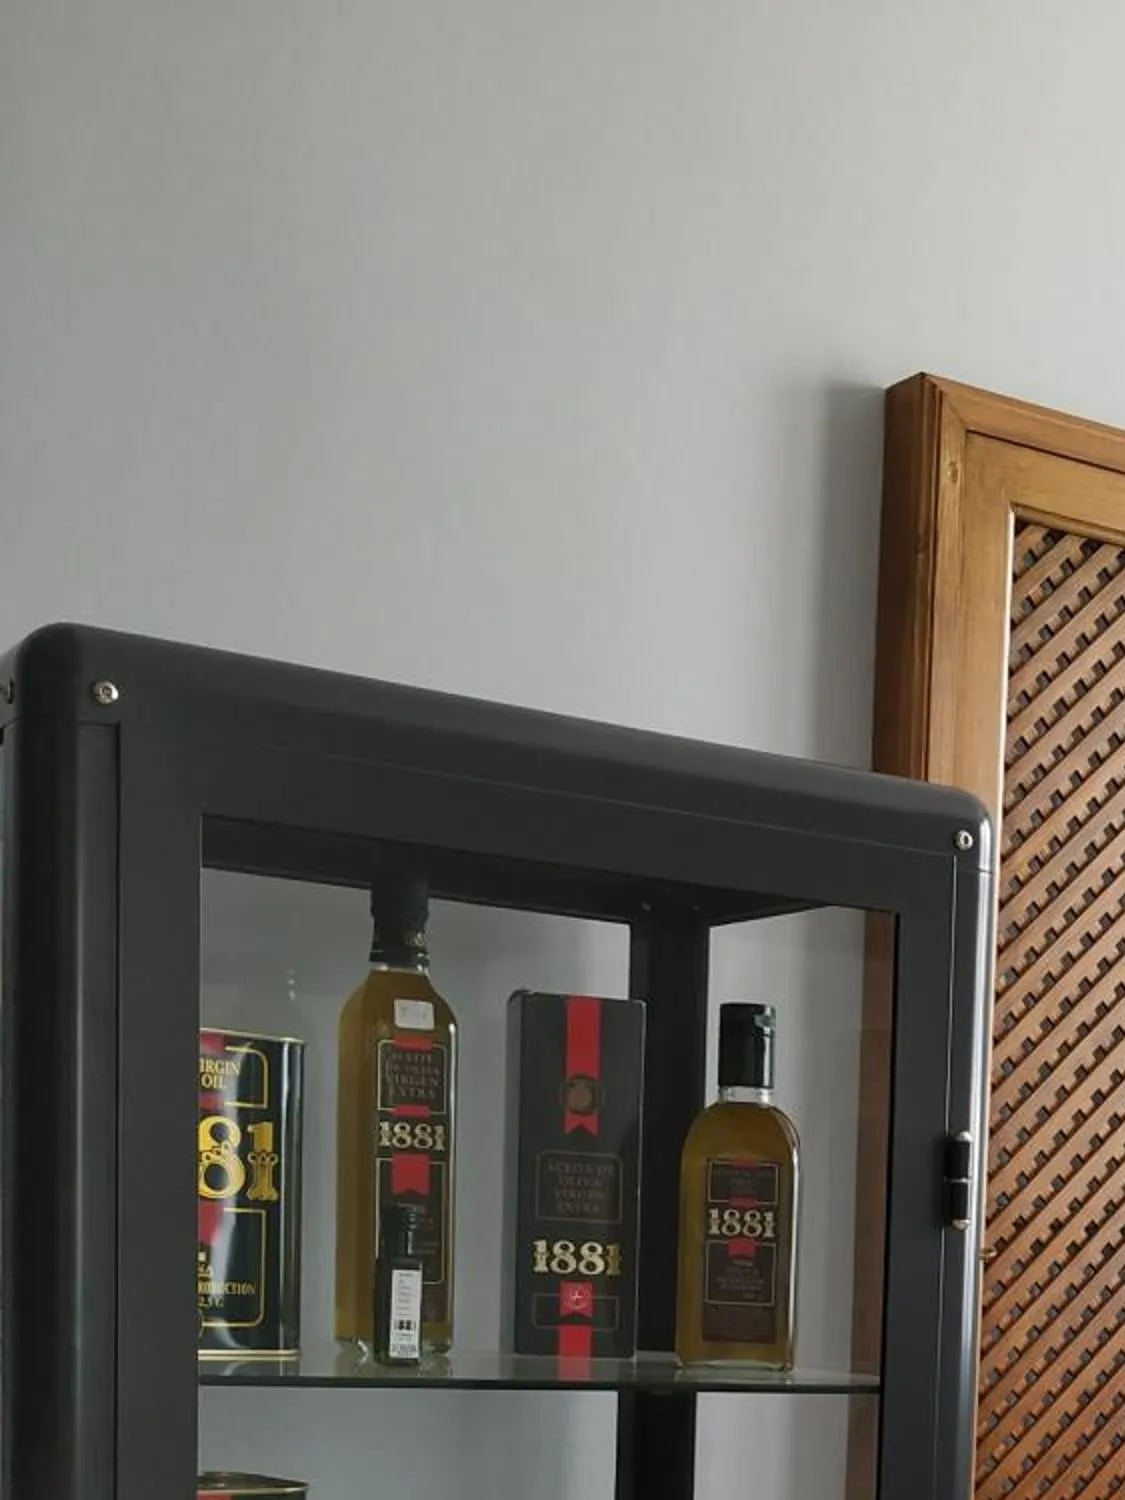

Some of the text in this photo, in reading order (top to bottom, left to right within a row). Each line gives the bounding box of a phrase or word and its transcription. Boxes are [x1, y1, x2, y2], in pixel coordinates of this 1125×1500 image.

[201, 1073, 228, 1090] OIL
[378, 1121, 446, 1151] 1881
[707, 1208, 776, 1238] 1881
[533, 1240, 622, 1276] 1881
